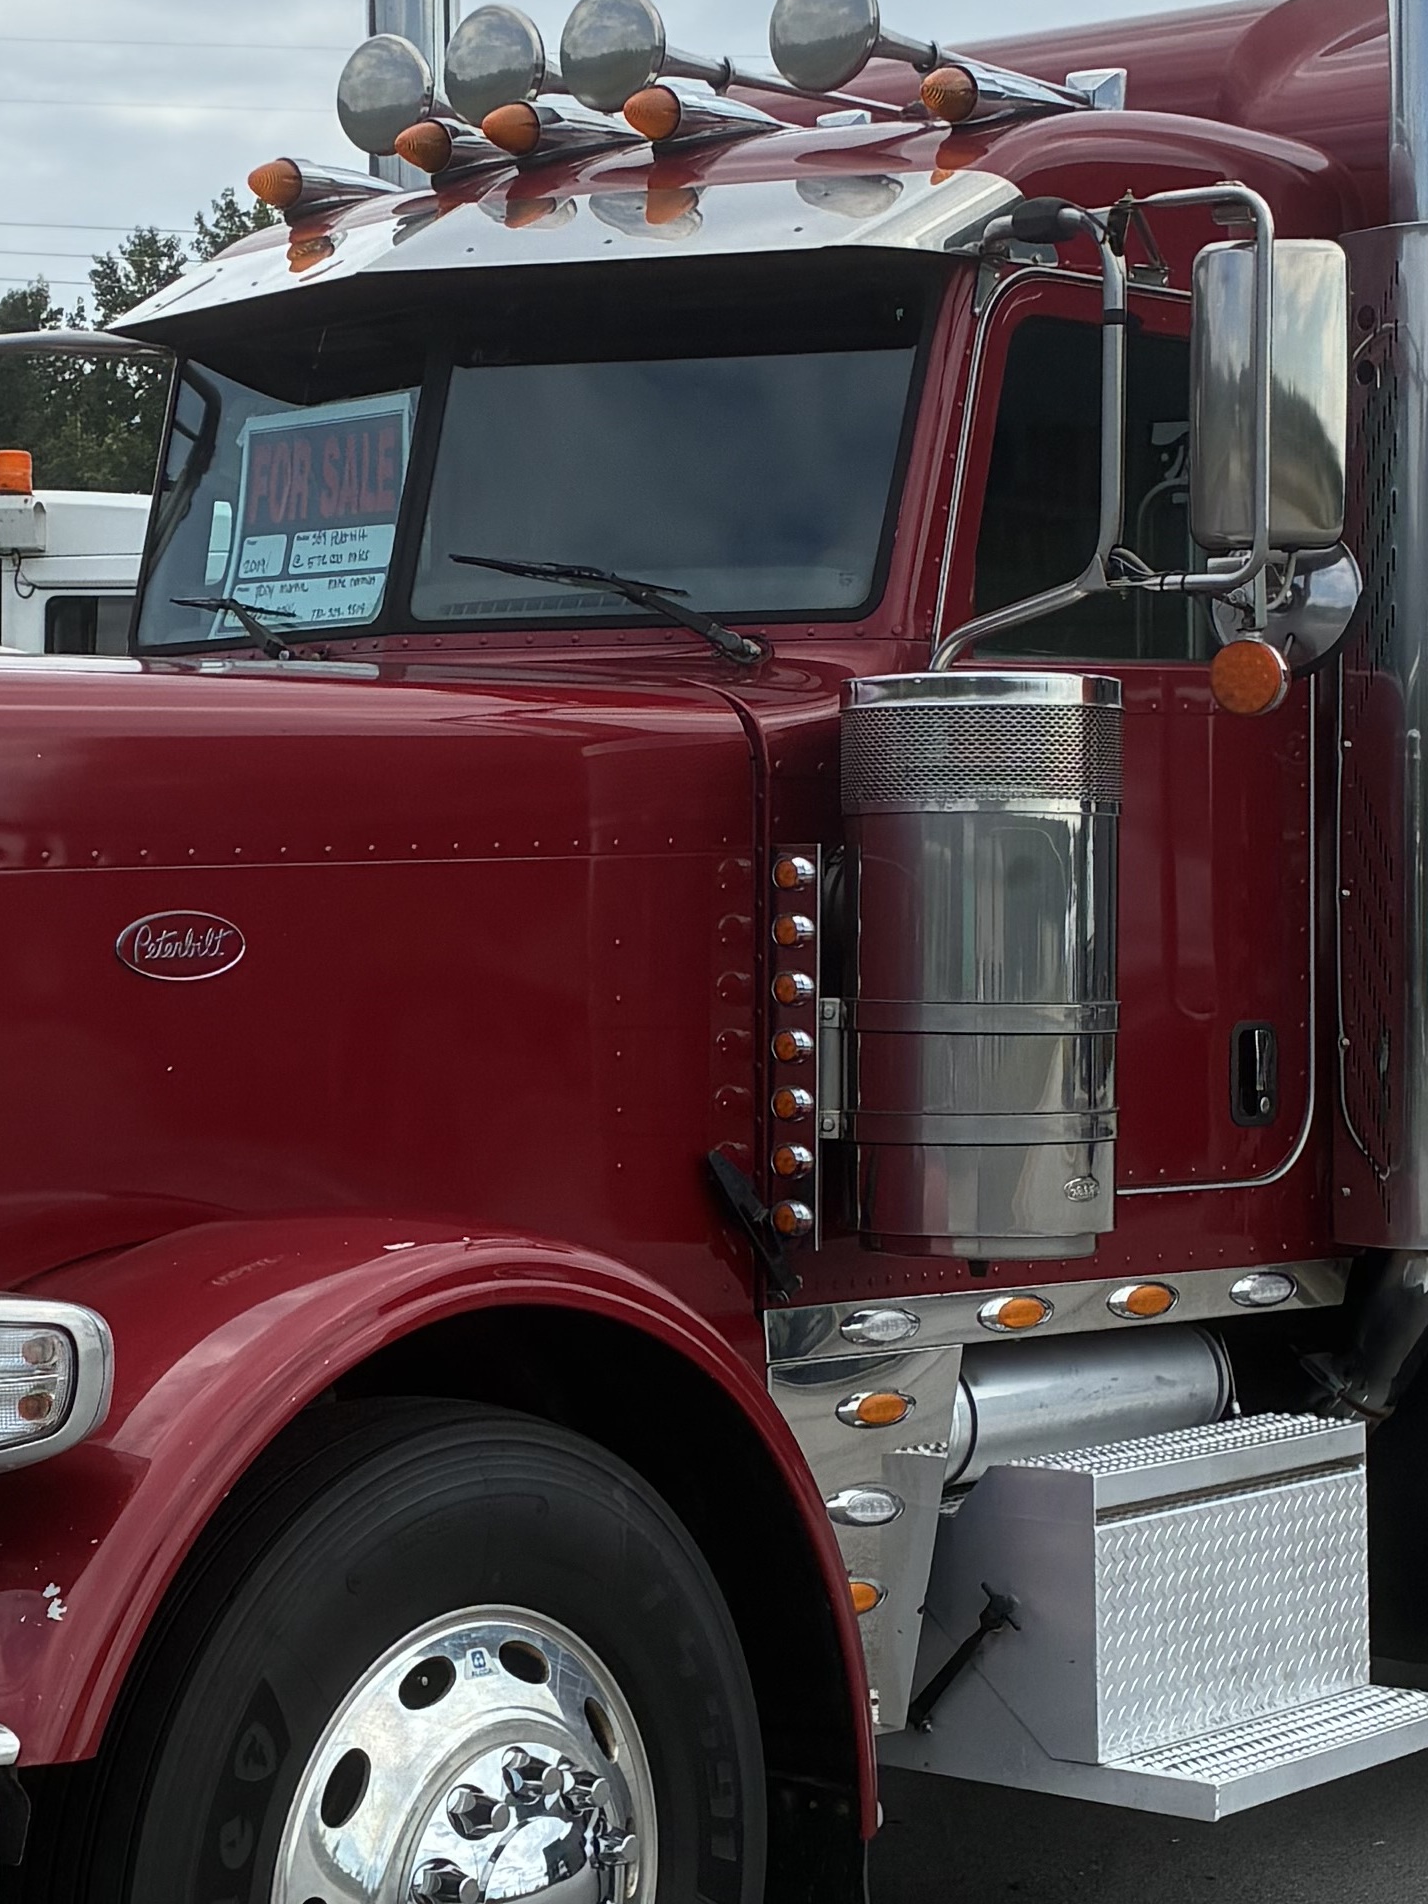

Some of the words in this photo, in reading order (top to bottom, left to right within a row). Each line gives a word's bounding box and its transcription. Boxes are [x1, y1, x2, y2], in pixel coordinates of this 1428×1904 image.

[247, 439, 311, 523] FOR
[320, 427, 397, 519] SALE
[132, 923, 235, 964] Peterbilt
